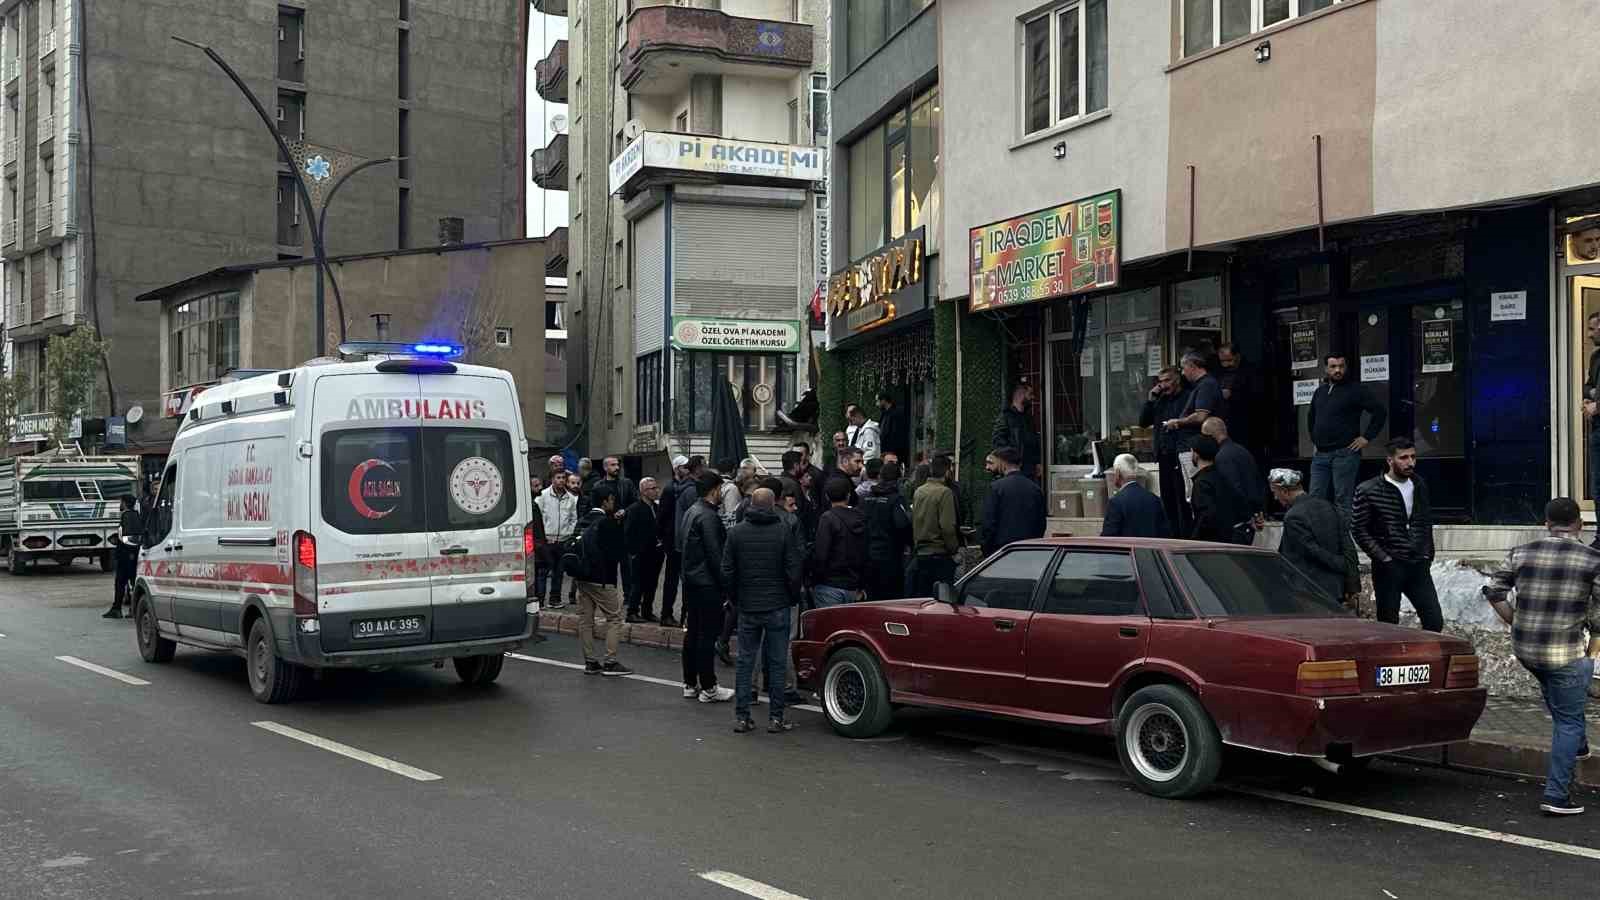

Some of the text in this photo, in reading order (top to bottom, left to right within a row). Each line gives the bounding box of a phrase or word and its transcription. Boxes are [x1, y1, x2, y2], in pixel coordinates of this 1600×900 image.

[680, 138, 818, 168] Pİ AKADEMİ
[990, 211, 1072, 254] IRAQDEM
[996, 251, 1066, 286] MARKET
[999, 287, 1019, 303] 0539
[1053, 280, 1064, 294] 30
[701, 326, 787, 337] ÖZEL OVA Pİ AKADEMİ
[701, 337, 787, 347] ÖZEL ÖĞRETİM KURSU
[346, 399, 487, 420] AMBULANS
[354, 551, 403, 559] TRANSIT
[359, 618, 419, 633] 30 AAC 395
[1381, 666, 1429, 684] 38 H 0922
